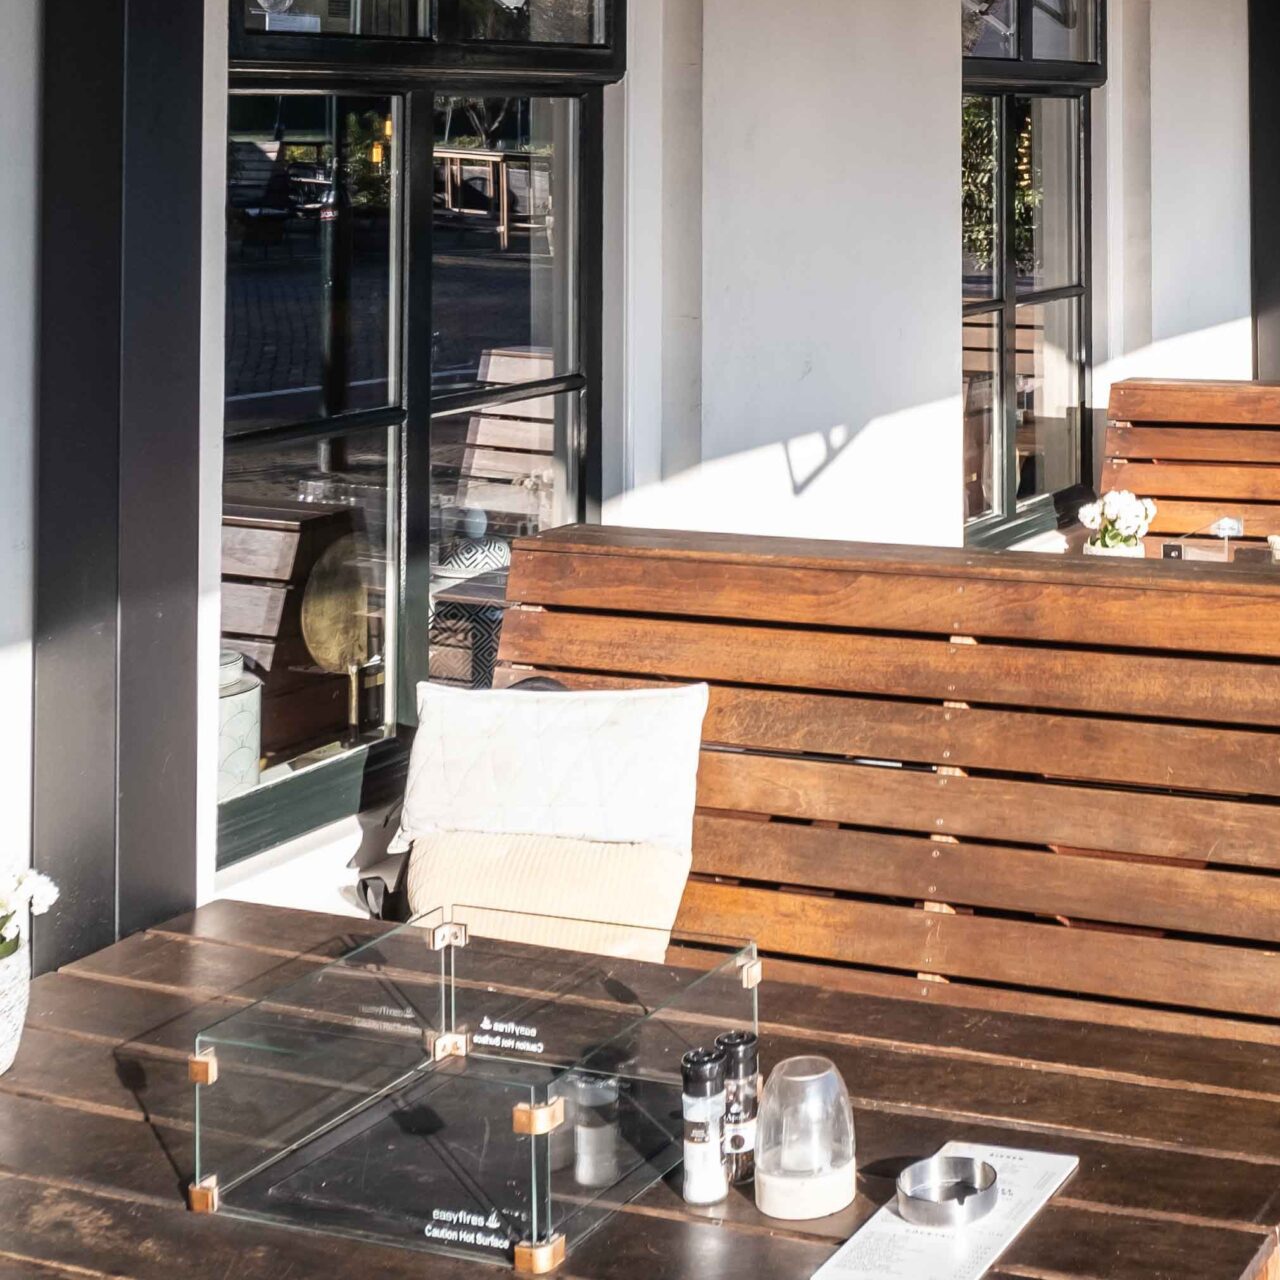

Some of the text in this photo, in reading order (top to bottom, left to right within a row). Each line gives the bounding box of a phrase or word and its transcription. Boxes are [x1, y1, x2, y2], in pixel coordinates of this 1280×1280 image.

[432, 1208, 485, 1227] easyfires
[424, 1224, 510, 1250] Caution Hot Surface
